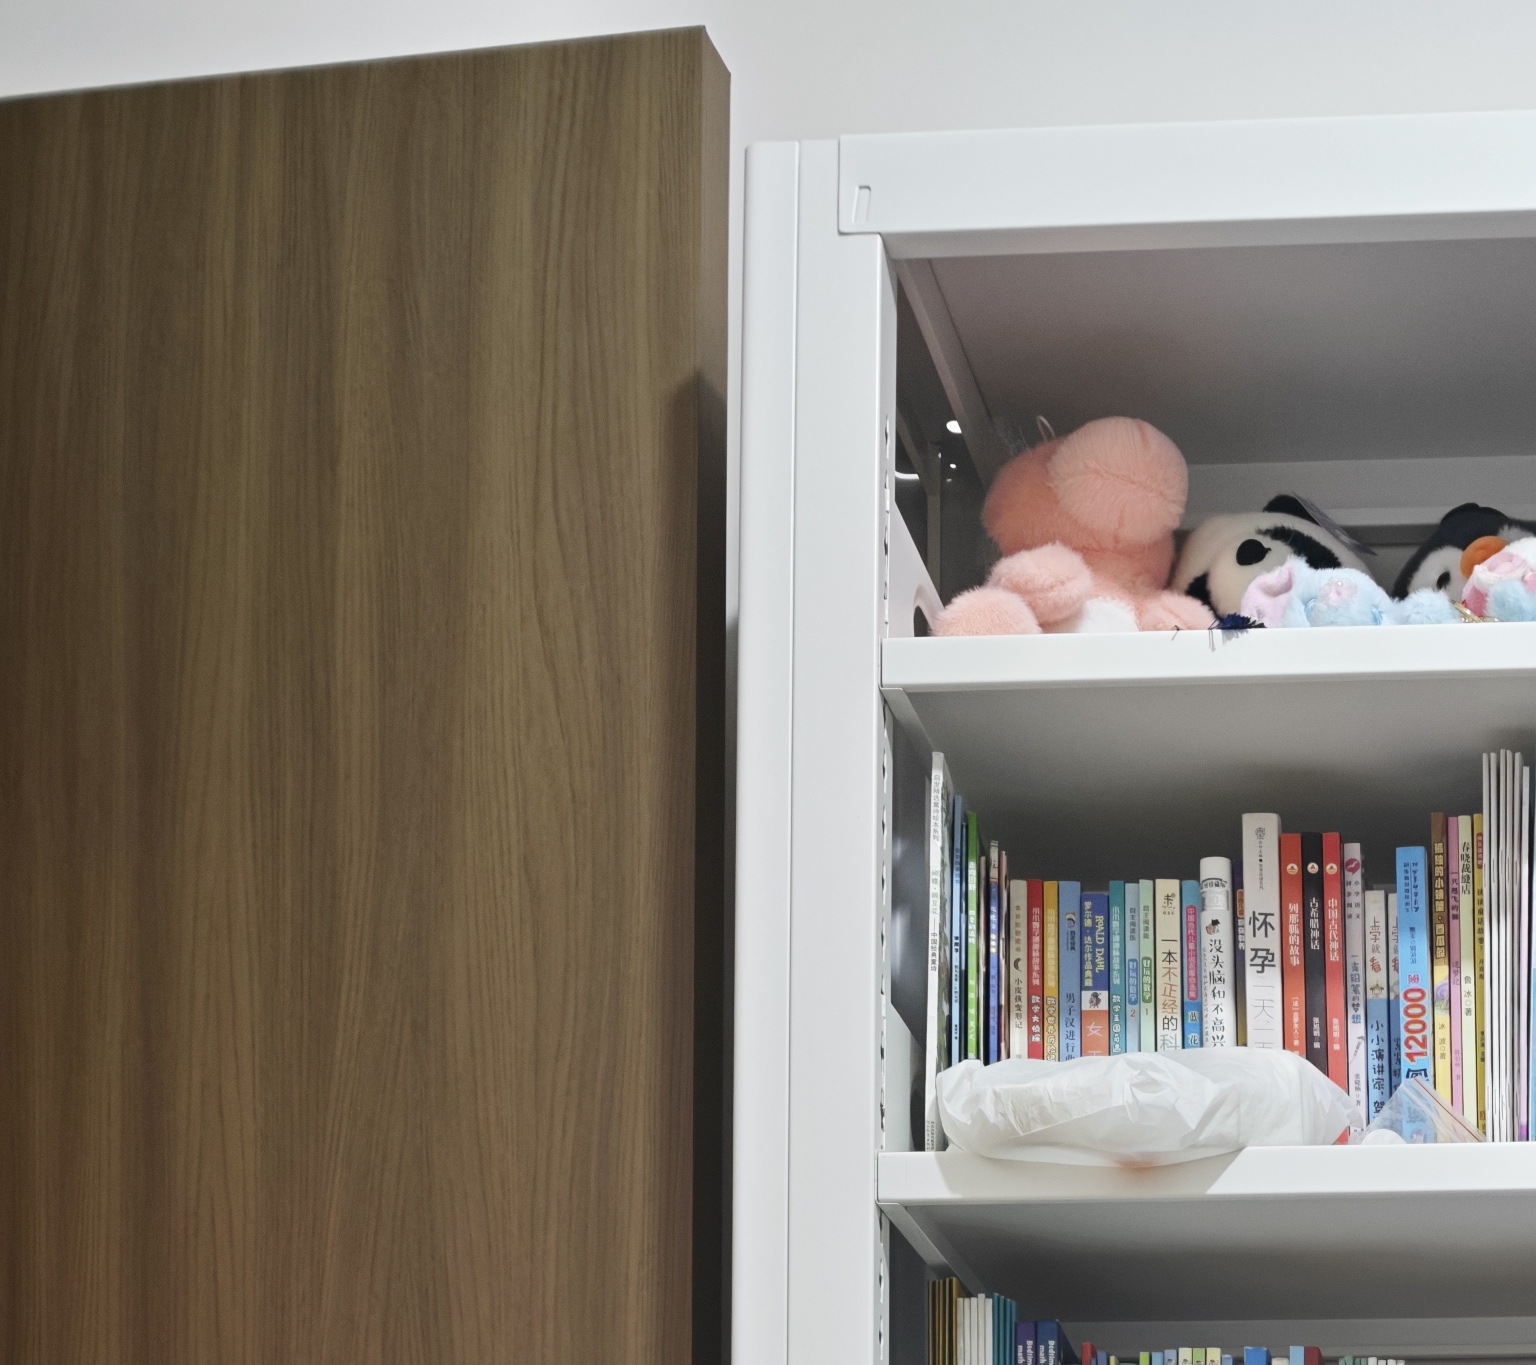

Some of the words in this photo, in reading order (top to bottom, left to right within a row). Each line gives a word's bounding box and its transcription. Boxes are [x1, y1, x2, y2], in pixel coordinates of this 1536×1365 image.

[1095, 915, 1105, 945] ROALD
[1248, 910, 1277, 974] 怀孕
[1289, 902, 1300, 967] 列那狐的故事
[1309, 897, 1320, 950] 古希腊神话
[1328, 898, 1340, 962] 中国古代神话
[1208, 938, 1226, 1047] 没头脑和不高兴
